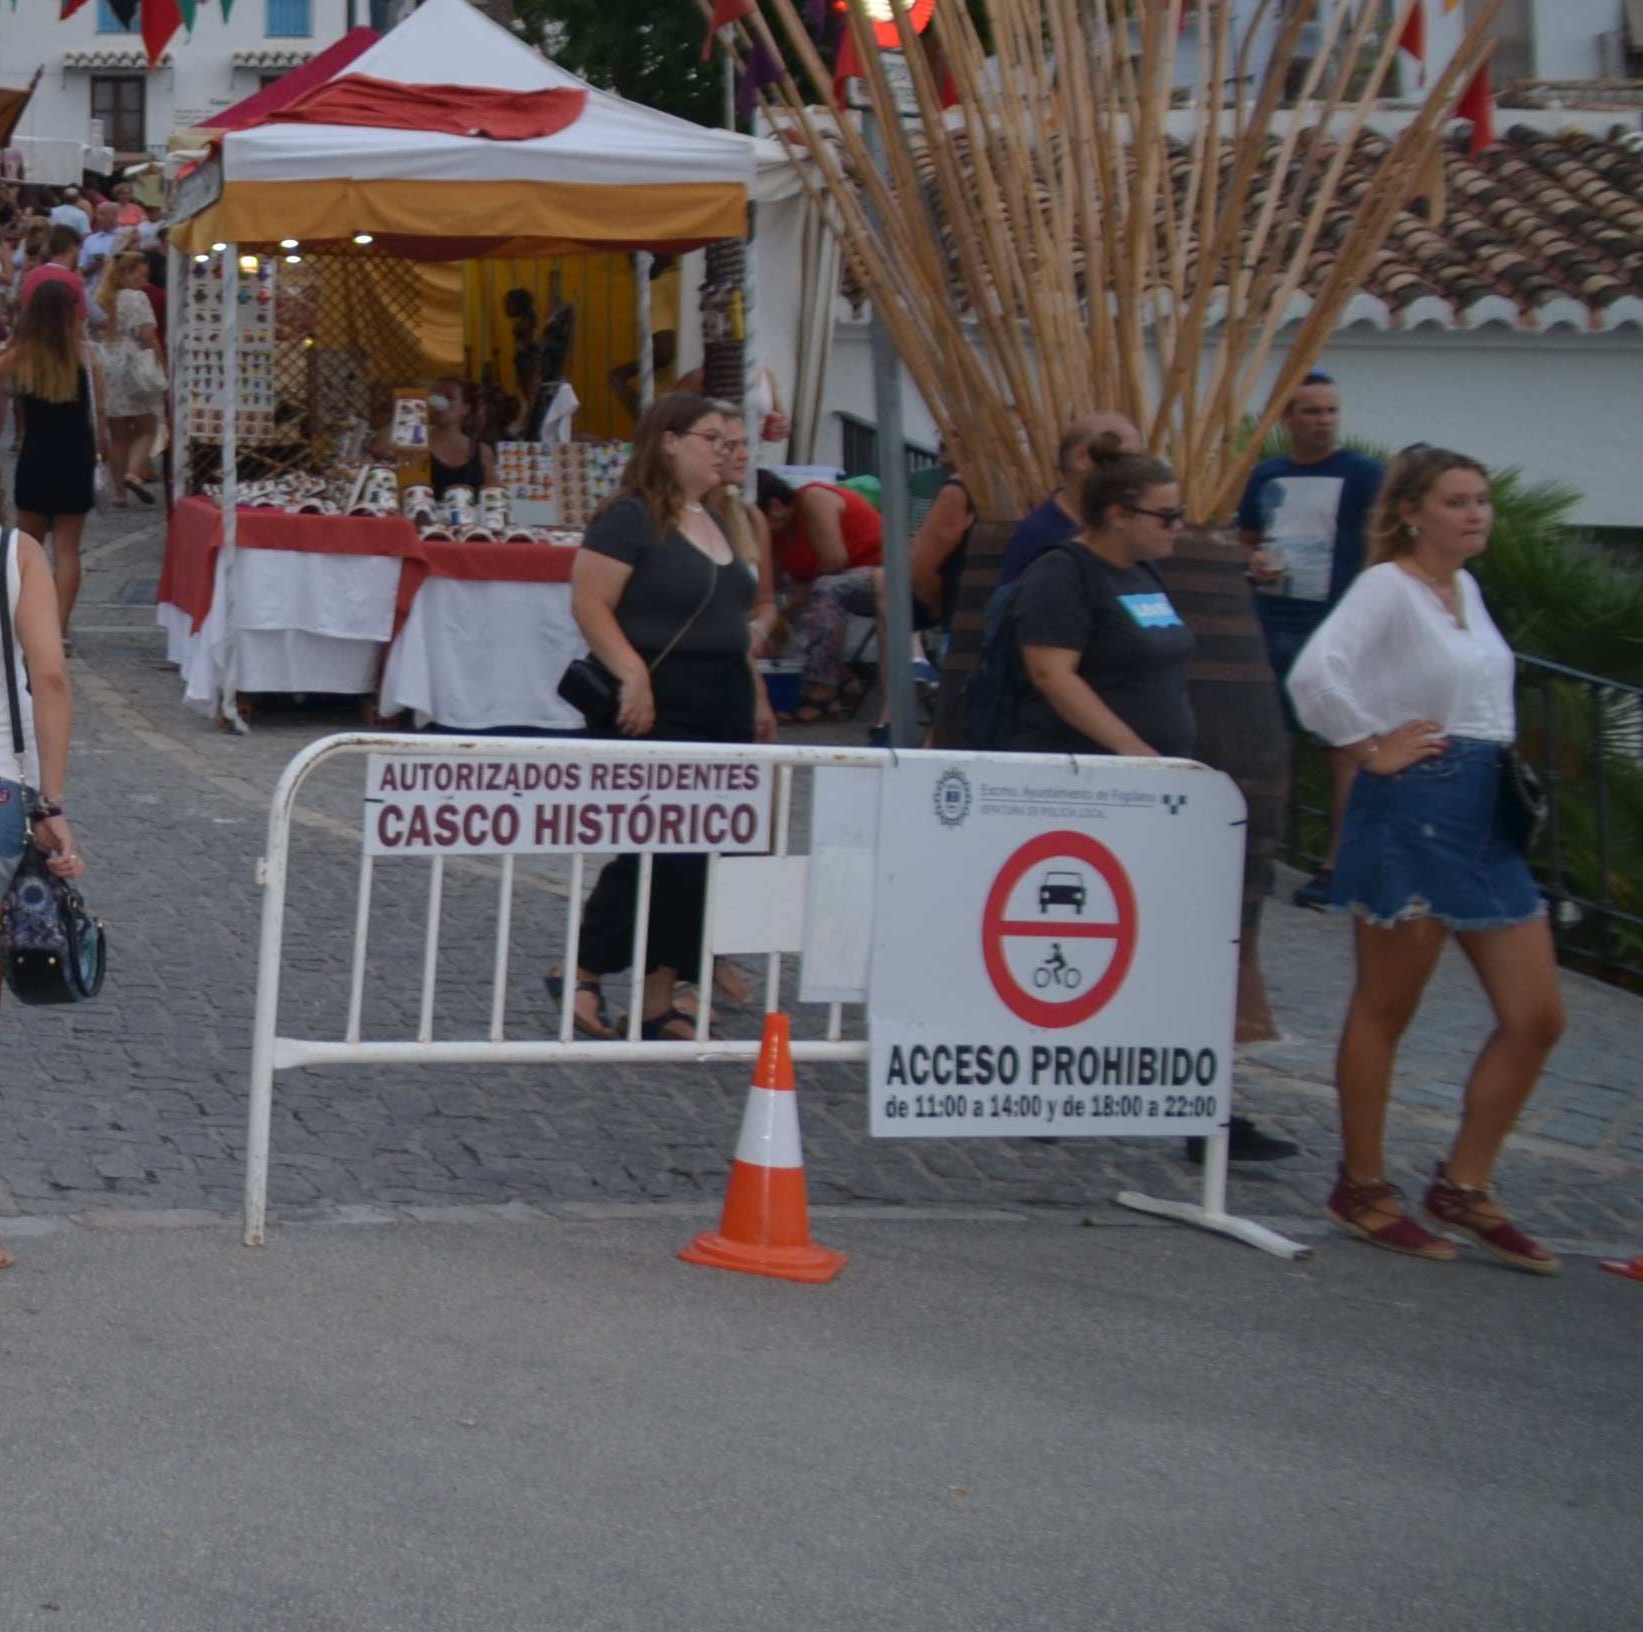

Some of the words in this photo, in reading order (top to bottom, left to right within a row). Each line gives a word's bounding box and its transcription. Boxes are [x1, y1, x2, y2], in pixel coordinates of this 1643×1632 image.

[380, 762, 580, 792] AUTORIZADOS
[590, 762, 759, 792] RESIDENTES
[378, 803, 520, 848] CASCO
[535, 793, 758, 847] HISTÓRICO
[887, 1044, 1019, 1086] ACCESO
[1031, 1045, 1217, 1087] PROHIBIDO
[886, 1095, 909, 1118] de
[915, 1095, 967, 1118] 11:00
[973, 1100, 983, 1118] a
[990, 1095, 1041, 1118] 14:00
[1047, 1100, 1058, 1123] y
[1063, 1095, 1085, 1118] de
[1092, 1095, 1142, 1117] 18:00
[1149, 1100, 1158, 1118] a
[1165, 1095, 1216, 1118] 22:00
